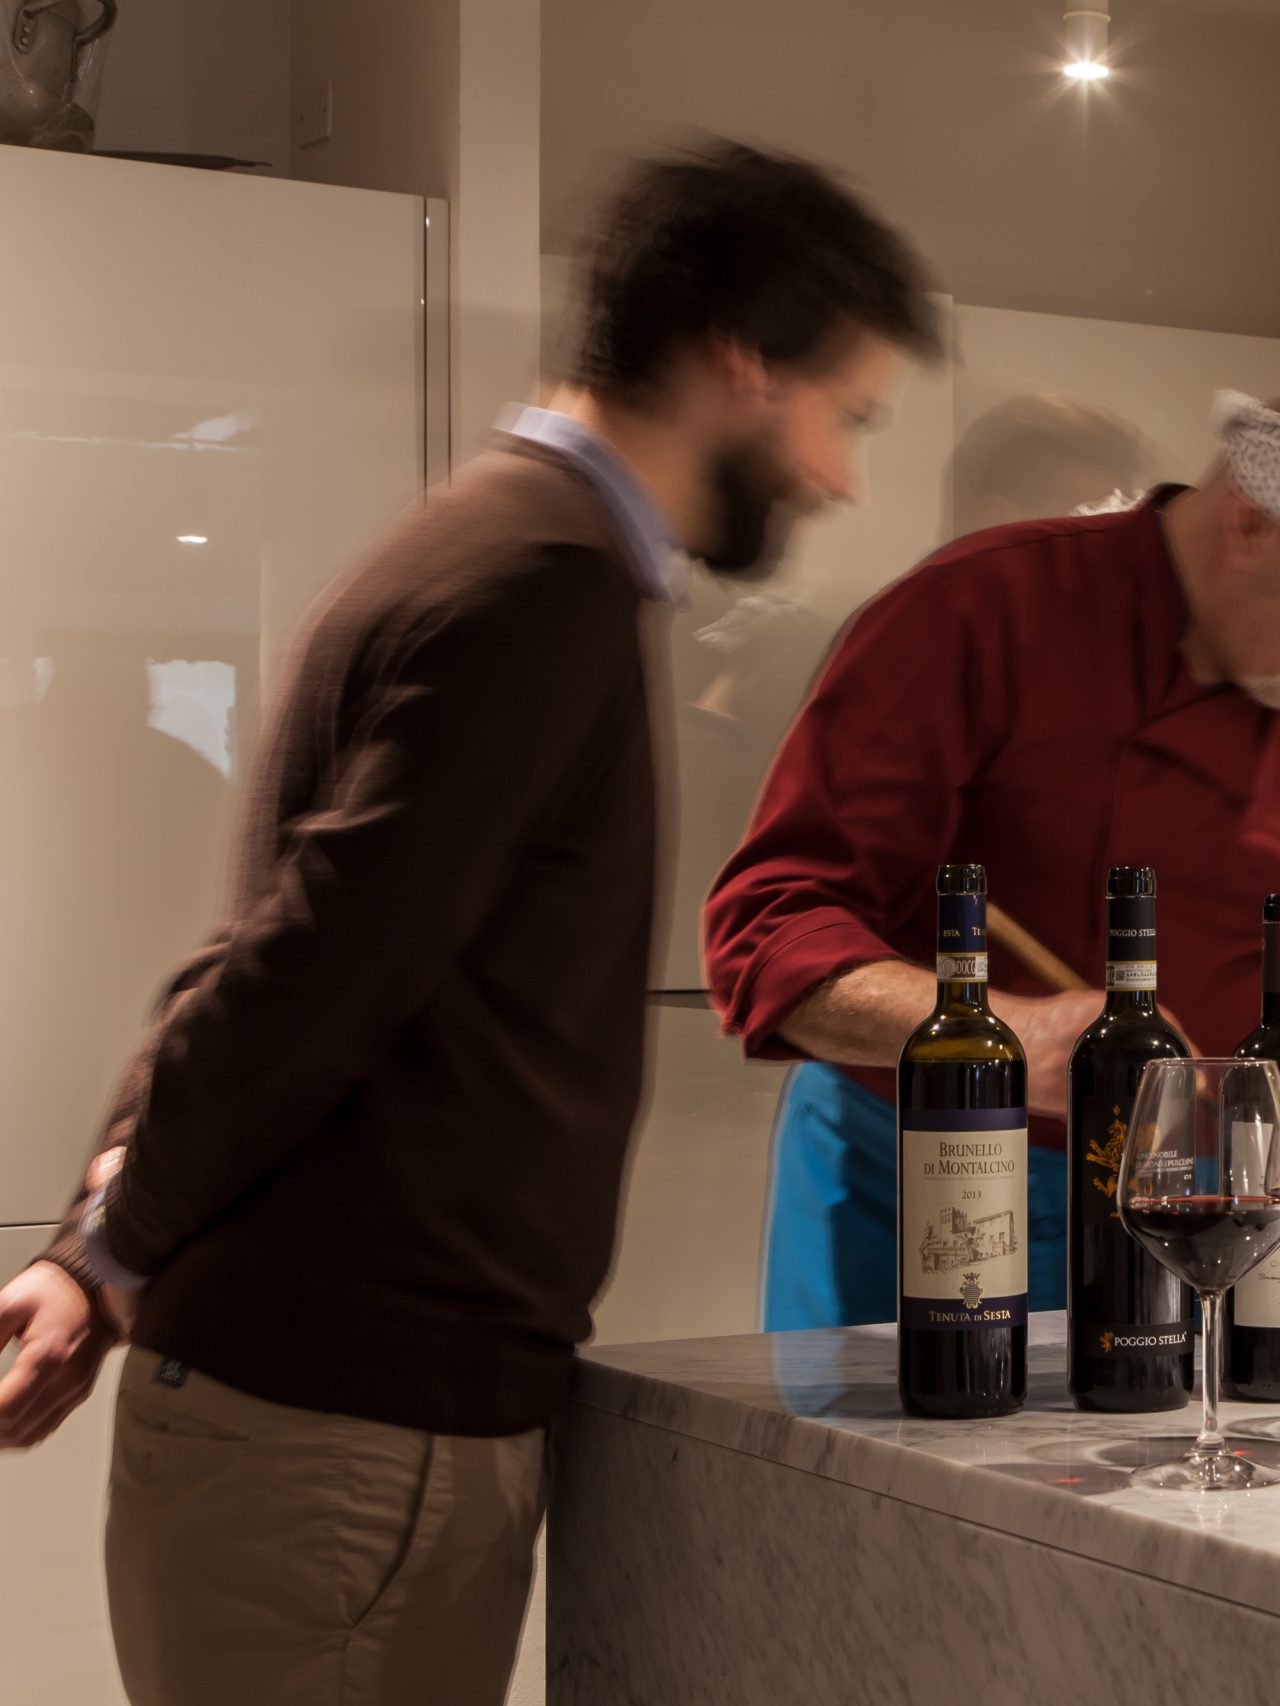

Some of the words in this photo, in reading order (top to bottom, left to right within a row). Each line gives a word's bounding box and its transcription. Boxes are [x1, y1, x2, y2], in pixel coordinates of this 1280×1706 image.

[942, 929, 960, 937] ESTA
[939, 1142, 1003, 1157] BRUNELLO
[923, 1164, 935, 1175] DI
[938, 1159, 1015, 1175] MONTALCINO
[962, 1190, 982, 1200] 2013
[928, 1311, 971, 1322] TENUTA
[974, 1314, 982, 1322] DI
[983, 1309, 1011, 1322] SESTA
[1114, 1336, 1157, 1347] POGGIO
